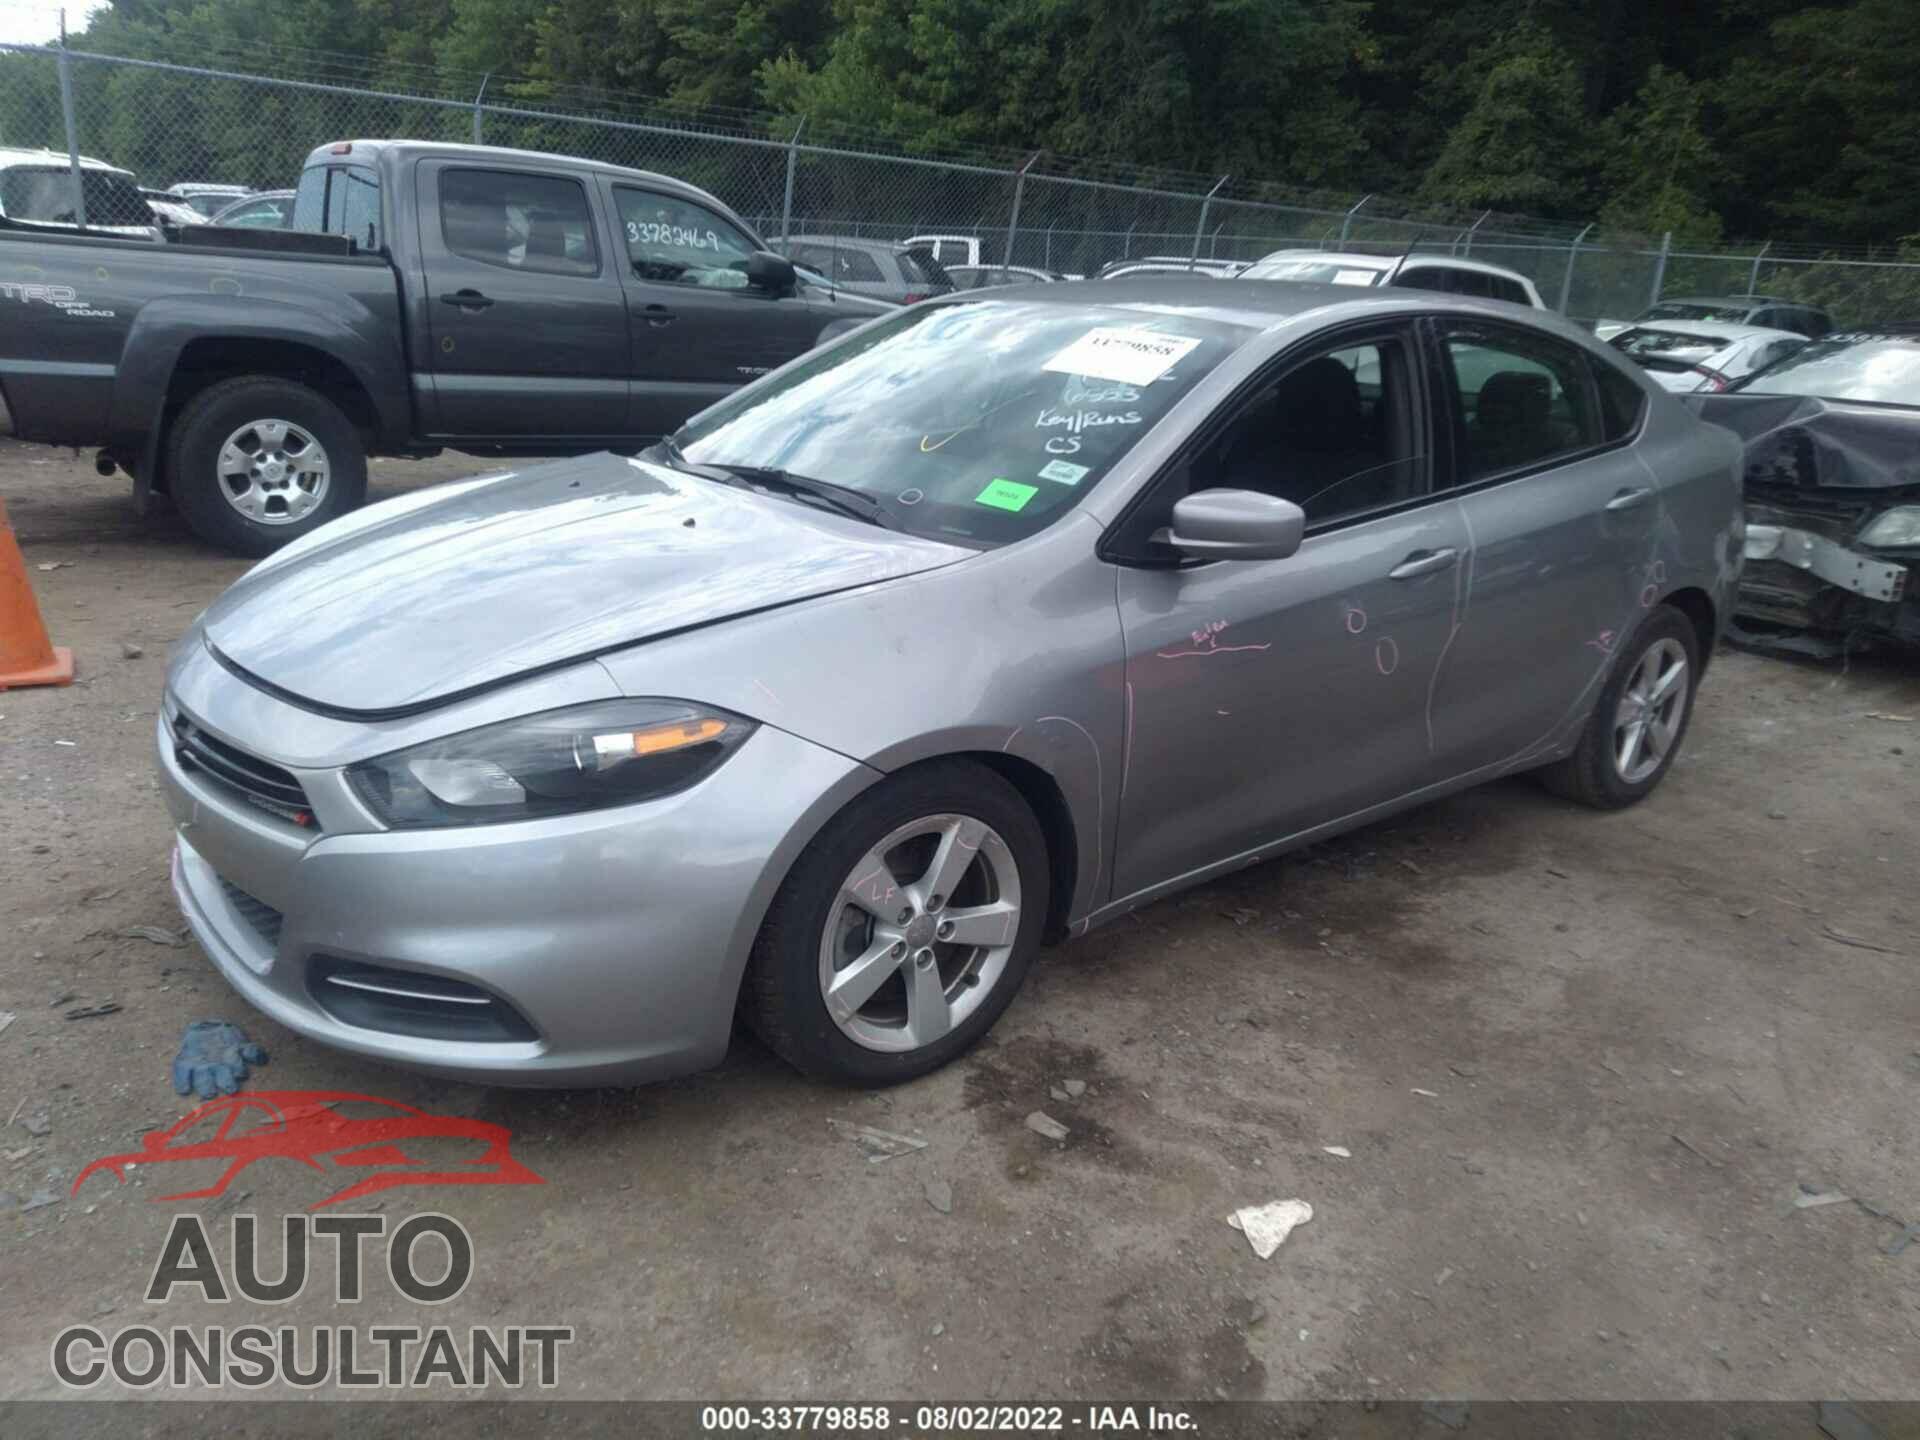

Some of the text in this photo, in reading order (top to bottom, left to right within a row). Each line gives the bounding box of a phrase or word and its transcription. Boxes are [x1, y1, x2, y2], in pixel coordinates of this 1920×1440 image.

[627, 222, 719, 251] 33782469
[0, 282, 76, 304] TRD
[55, 301, 90, 309] OFF
[66, 308, 115, 317] ROAD
